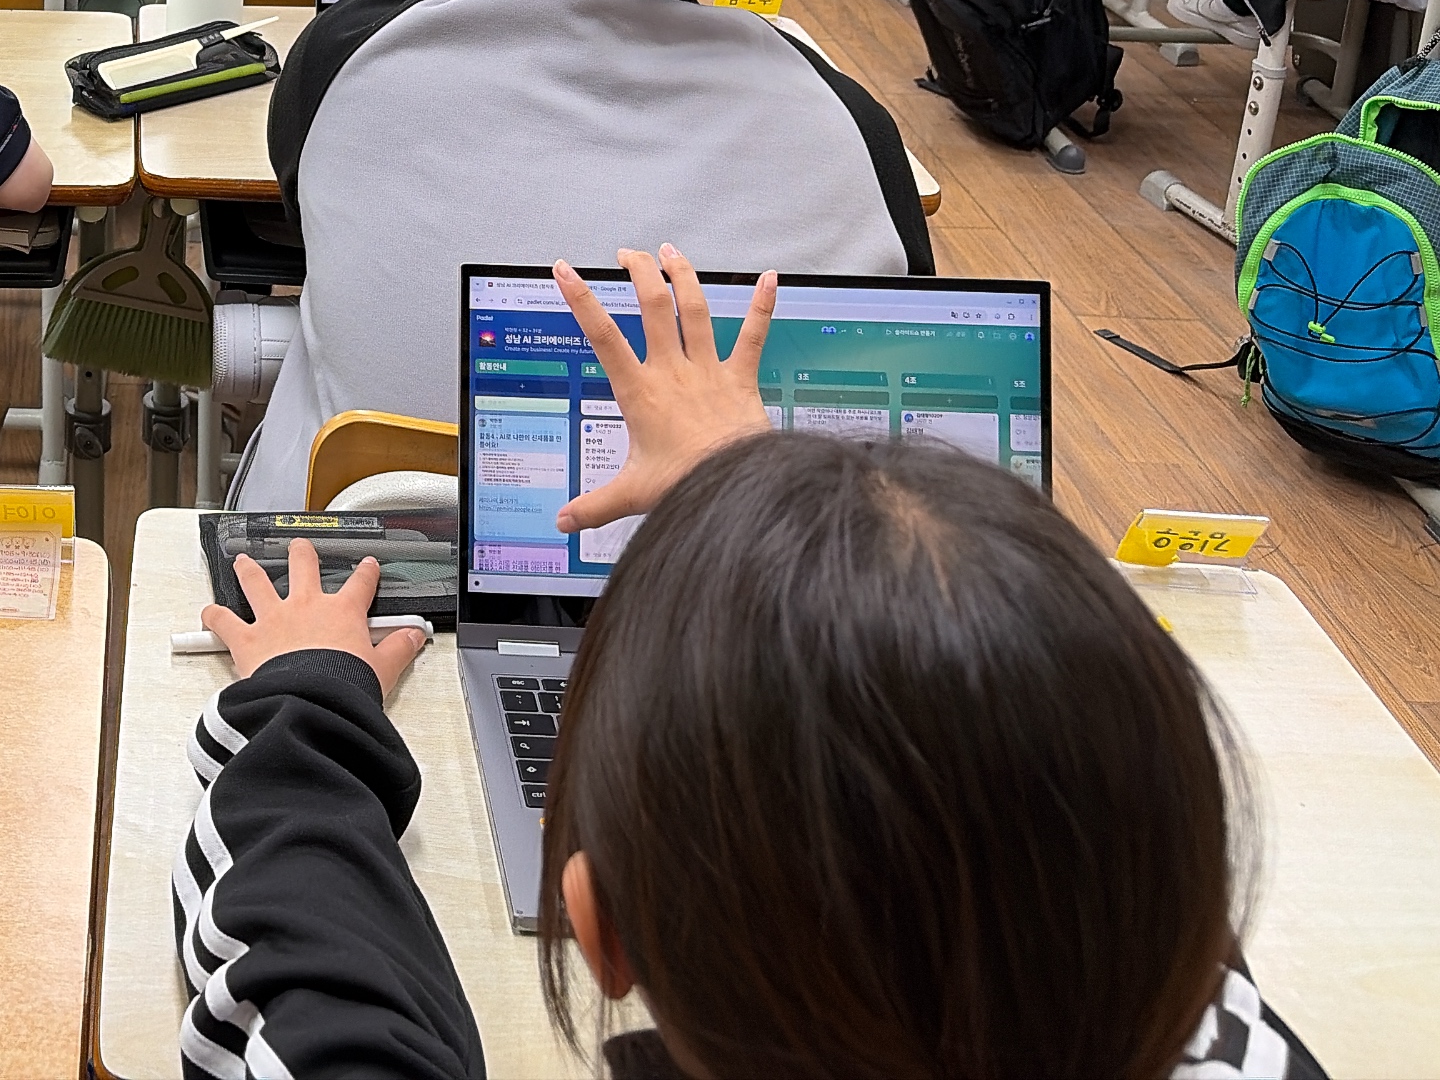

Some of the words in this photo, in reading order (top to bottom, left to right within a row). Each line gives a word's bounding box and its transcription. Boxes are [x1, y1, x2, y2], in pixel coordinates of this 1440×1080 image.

[505, 336, 521, 344] 성남
[533, 337, 581, 346] 크리에이터즈
[479, 362, 506, 371] 활동안내
[1014, 380, 1026, 388] 5조
